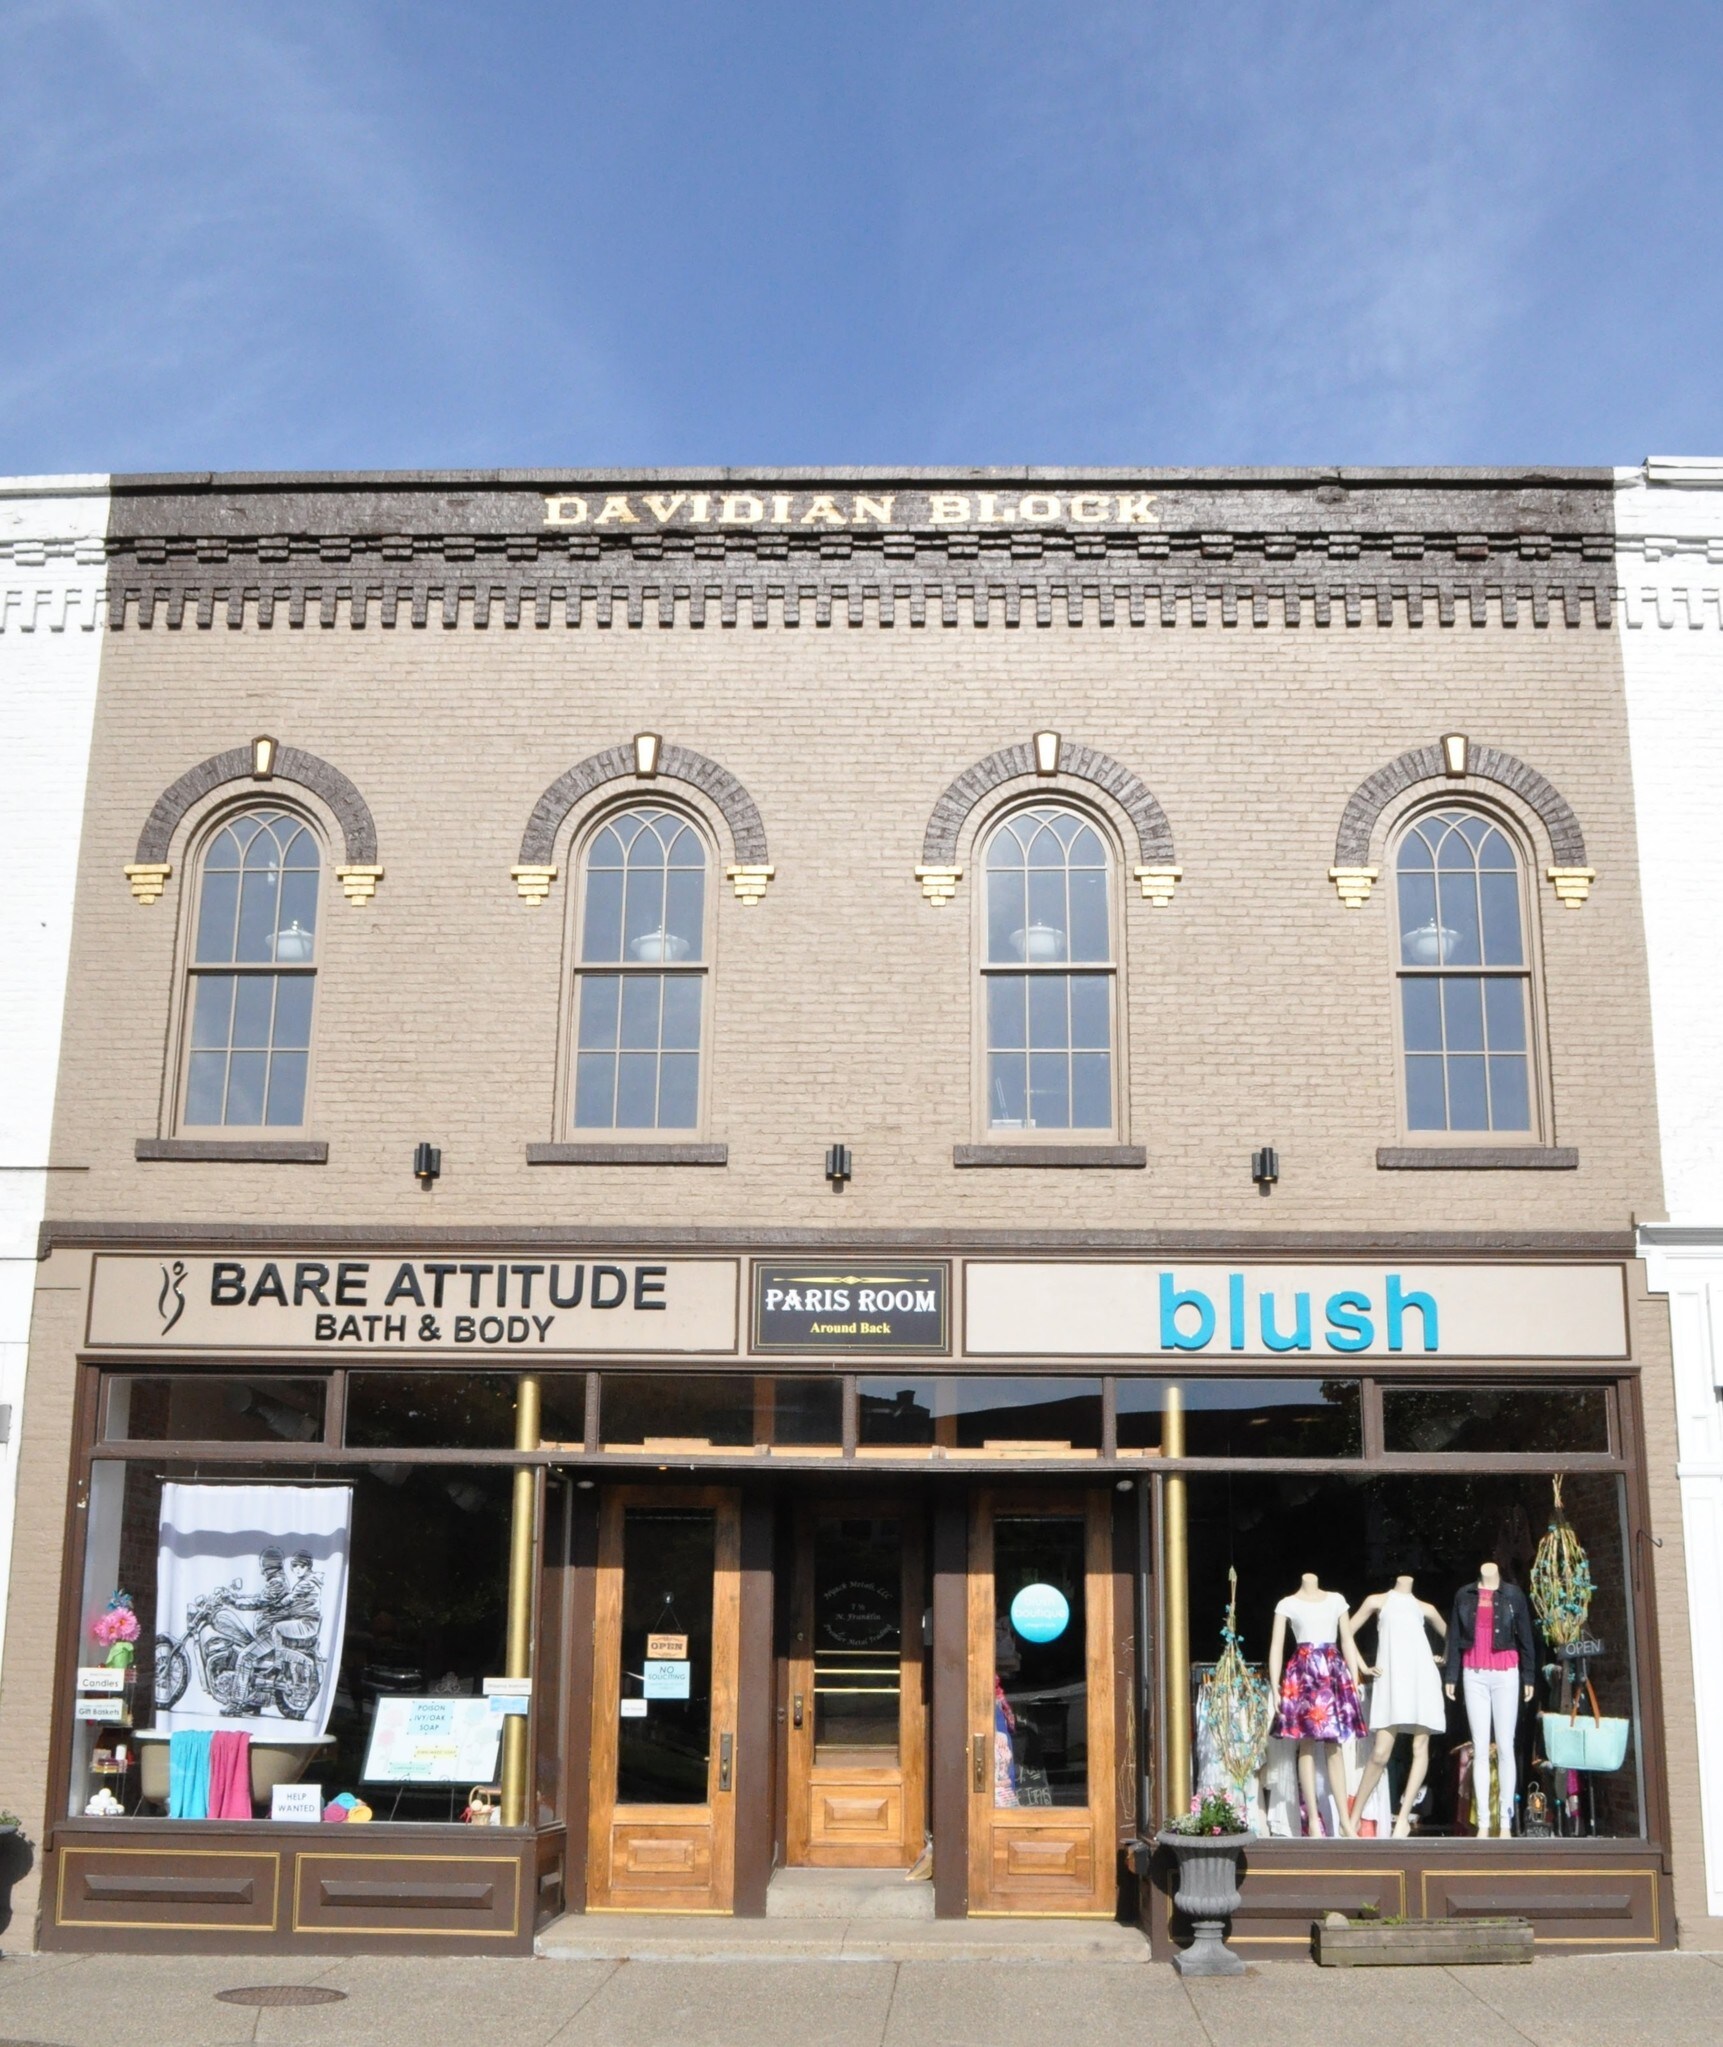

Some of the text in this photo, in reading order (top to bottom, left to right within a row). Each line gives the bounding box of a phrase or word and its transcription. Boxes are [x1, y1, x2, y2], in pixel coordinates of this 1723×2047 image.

[543, 494, 1159, 525] DAVIDIAN BLOCK
[211, 1262, 667, 1310] BARE ATTITUDE
[765, 1288, 937, 1313] PARIS ROOM
[1159, 1272, 1439, 1352] blush
[315, 1313, 556, 1343] BATH & BODY
[810, 1322, 891, 1334] Around Back
[1015, 1606, 1066, 1619] boutique
[651, 1642, 683, 1651] OPEN
[1565, 1639, 1601, 1656] OPEN
[660, 1666, 675, 1674] NO
[82, 1678, 119, 1688] Candles
[648, 1673, 686, 1681] SOLICITING
[286, 1792, 307, 1801] HELP
[278, 1804, 316, 1813] WANTED
